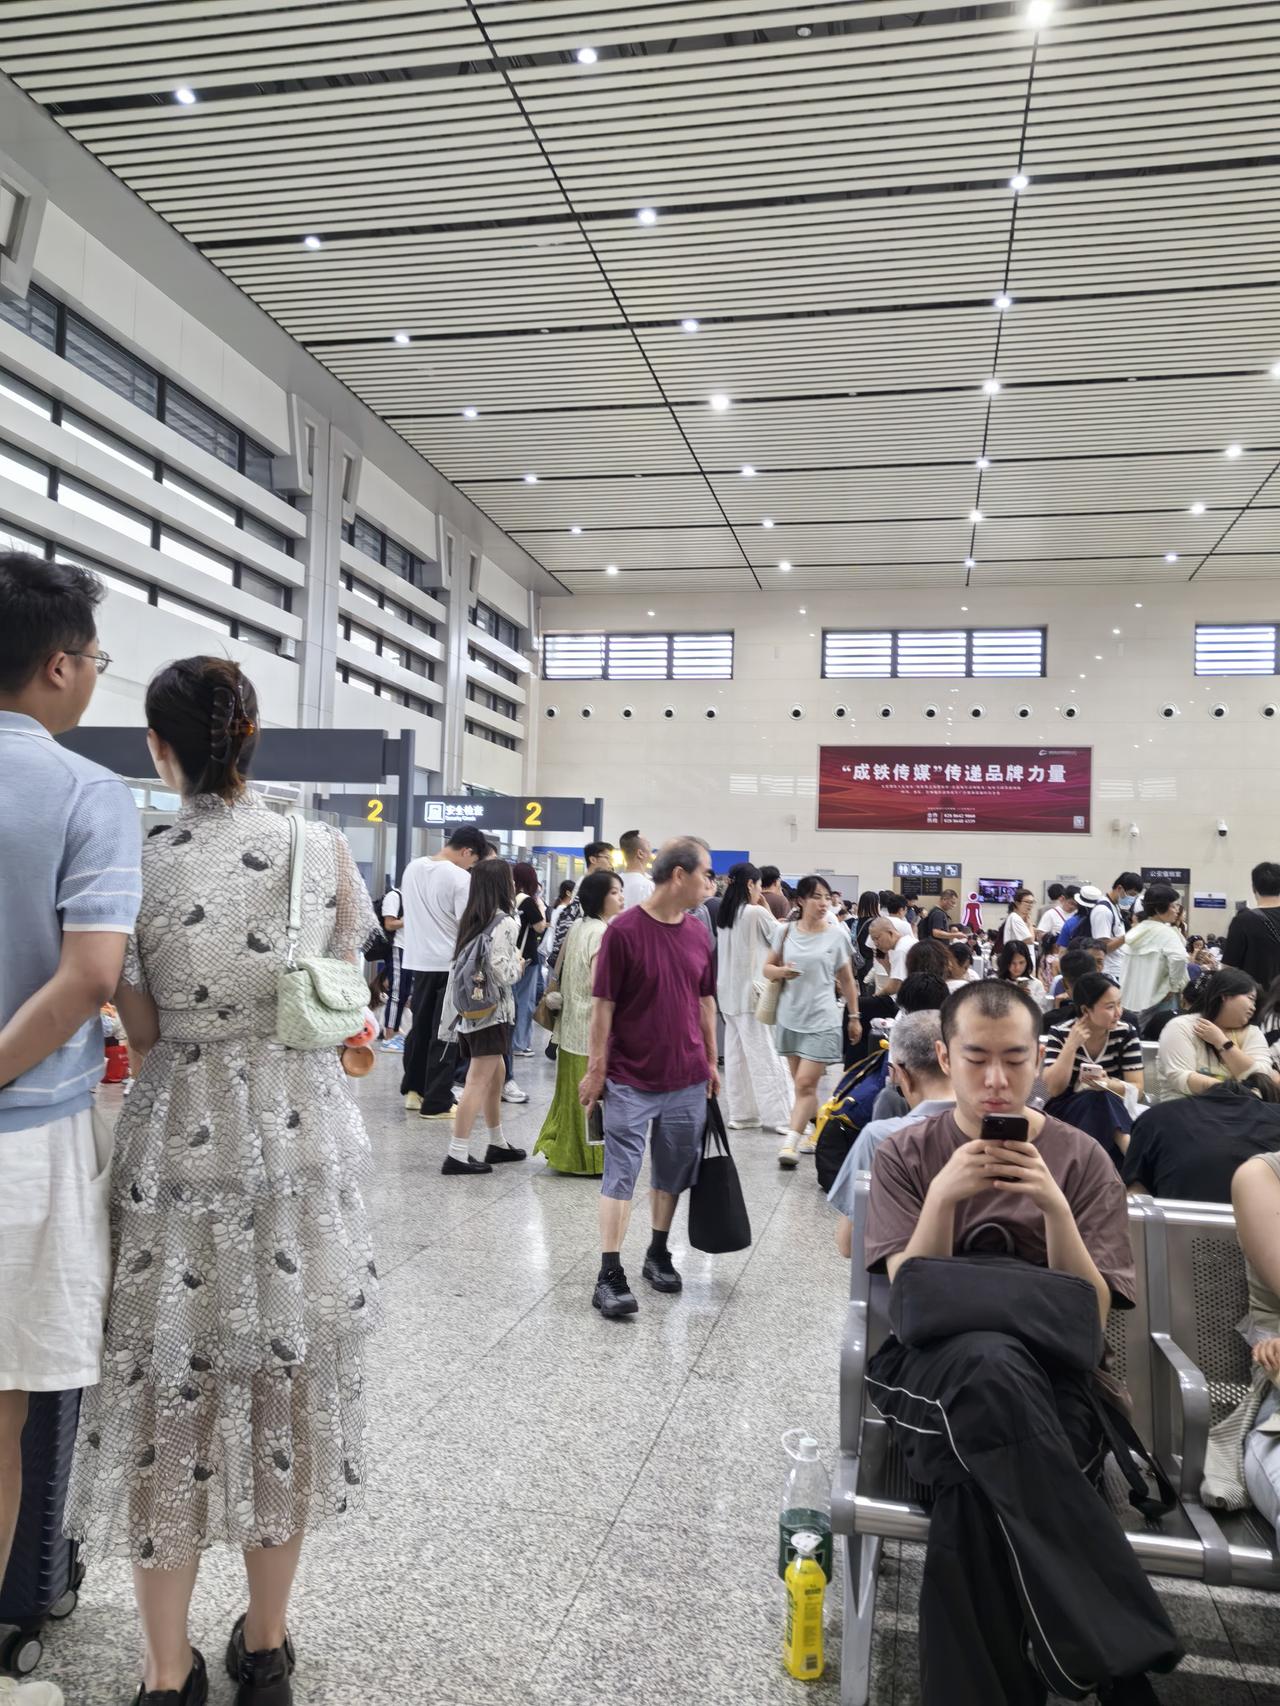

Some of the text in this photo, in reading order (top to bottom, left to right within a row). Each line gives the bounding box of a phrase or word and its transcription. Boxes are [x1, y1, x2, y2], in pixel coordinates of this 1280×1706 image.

[842, 763, 1066, 783] “成铁传媒”传递品牌力量
[367, 799, 384, 823] 2
[445, 804, 484, 816] 安全检查
[524, 801, 542, 826] 2
